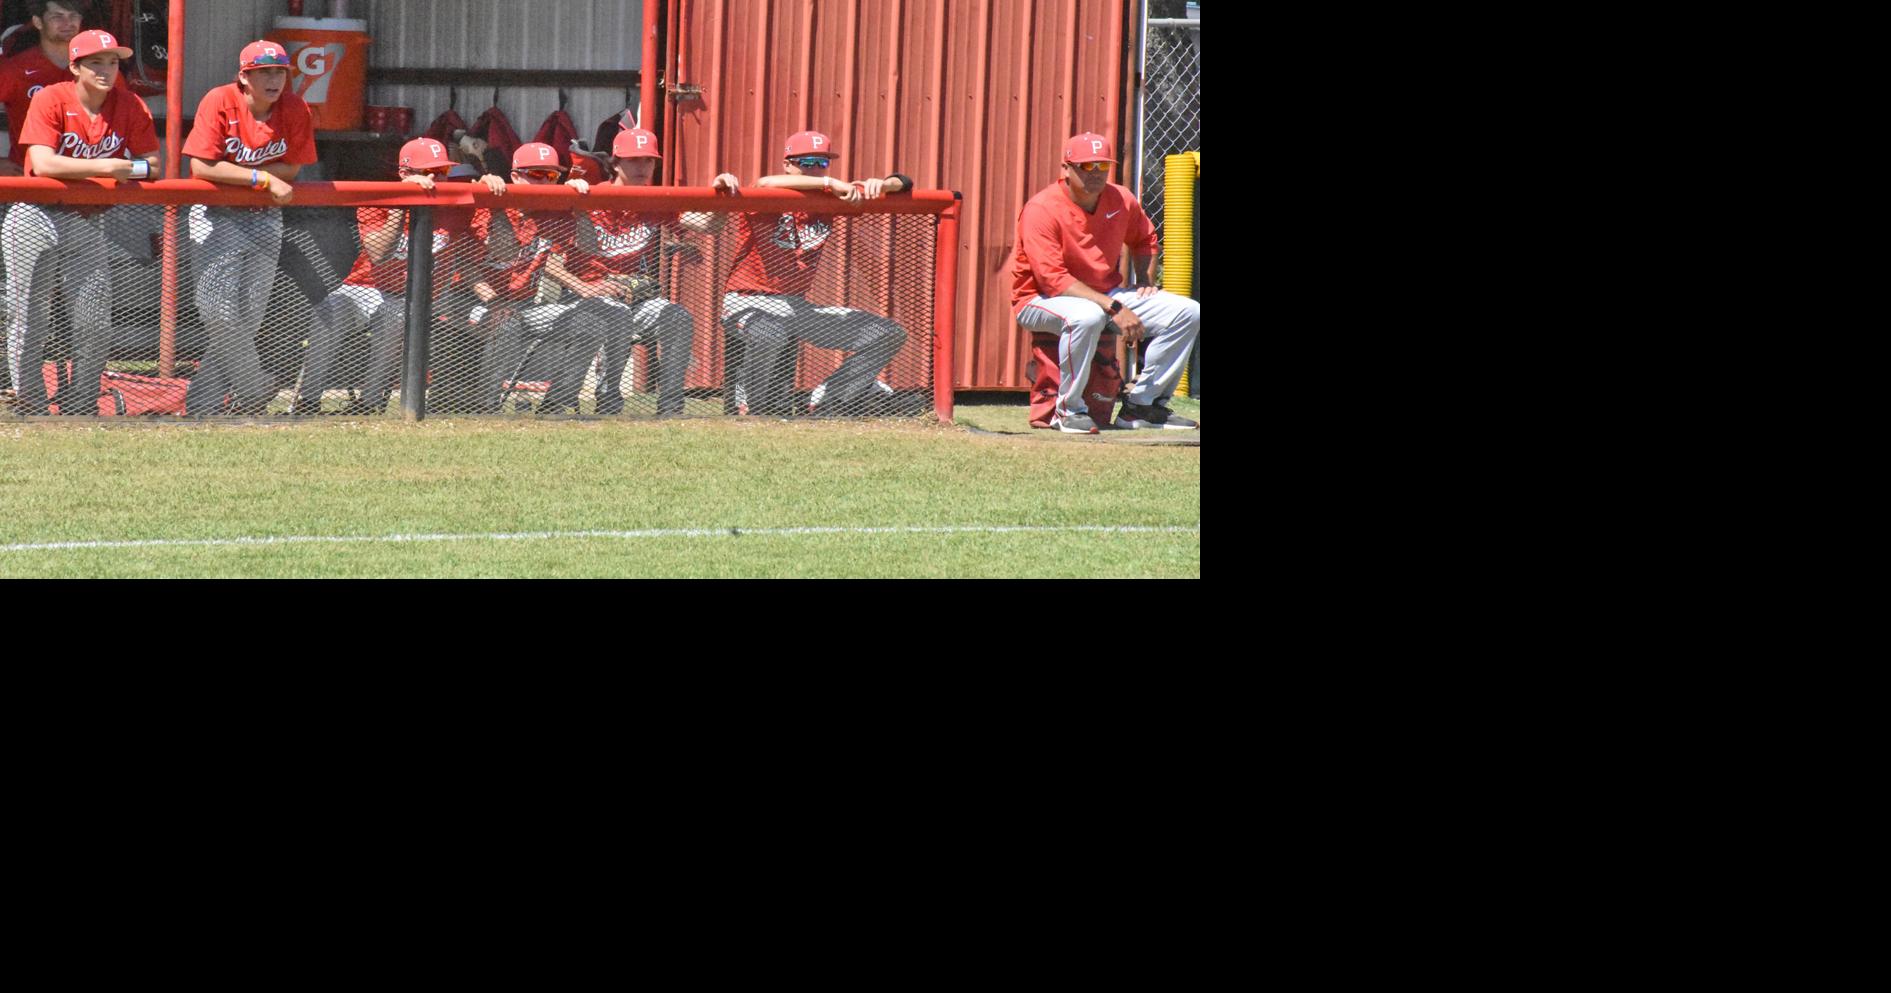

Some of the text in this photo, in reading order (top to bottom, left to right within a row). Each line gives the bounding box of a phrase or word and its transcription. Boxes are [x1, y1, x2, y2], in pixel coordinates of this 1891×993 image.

[99, 33, 112, 48] P
[297, 46, 325, 75] G
[58, 131, 124, 159] Pirates
[635, 135, 648, 149] P
[811, 136, 824, 149] P
[1091, 140, 1103, 154] P
[225, 137, 288, 164] Pirates
[430, 144, 442, 158] P
[538, 147, 550, 161] P
